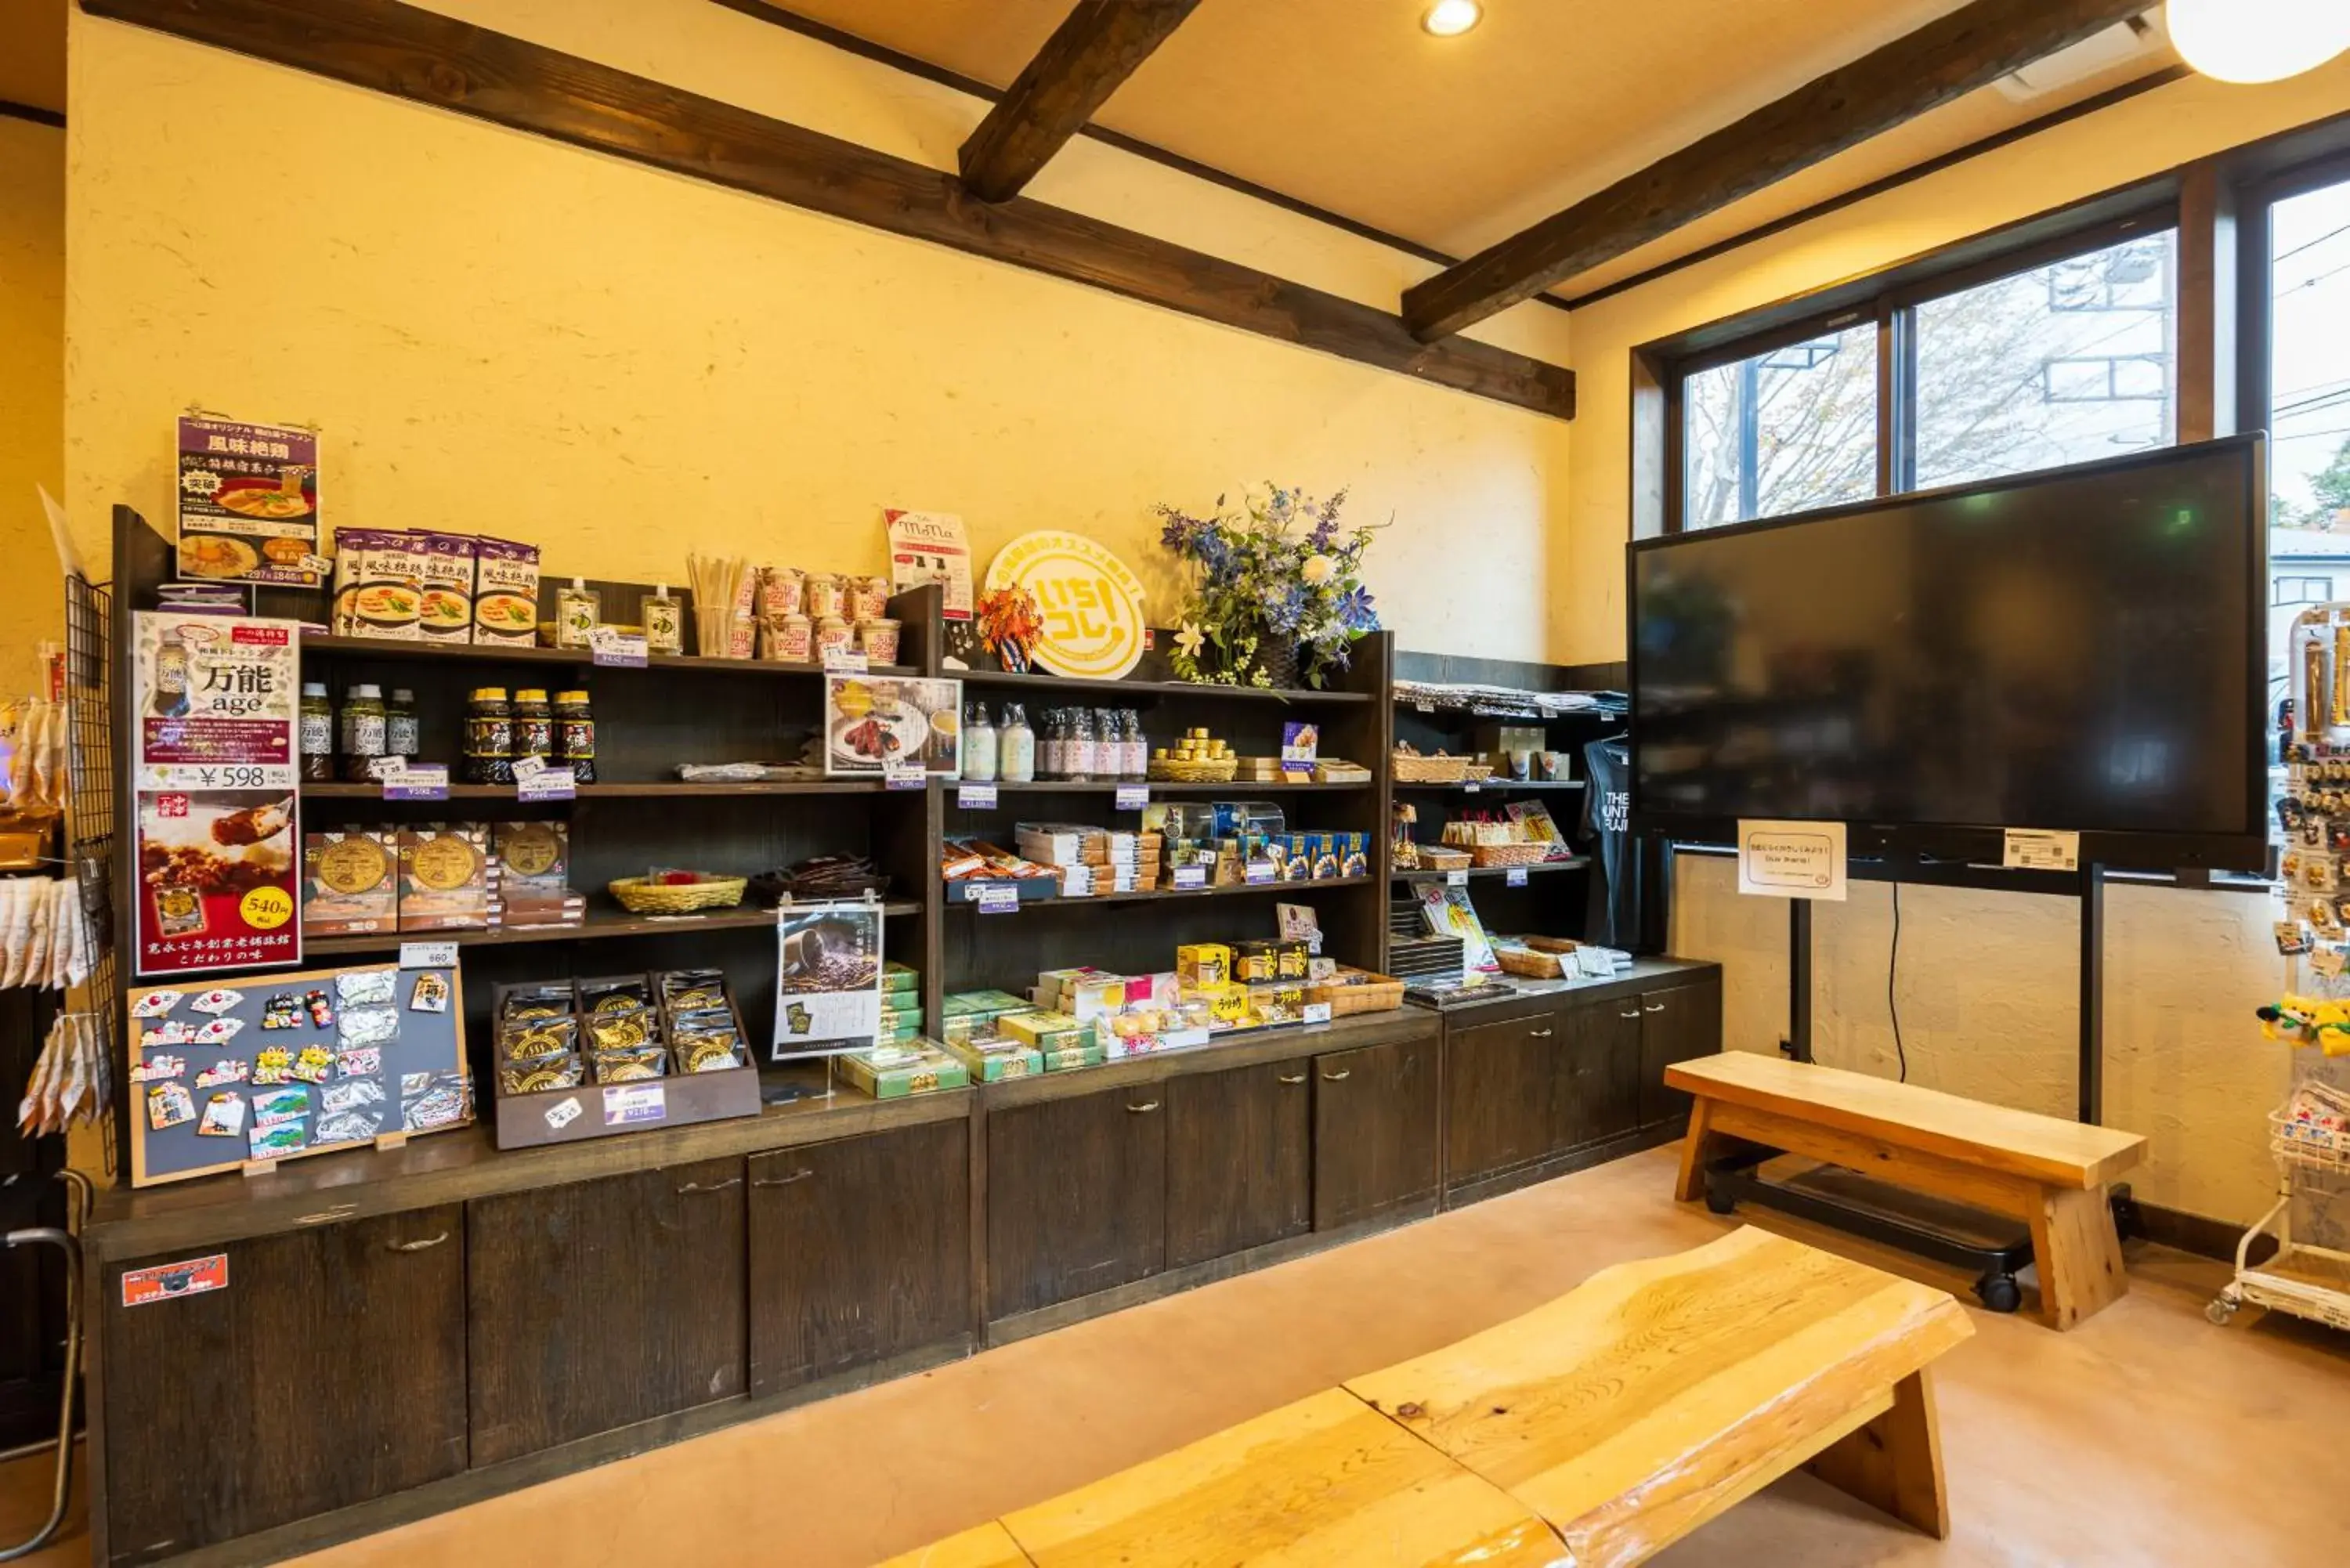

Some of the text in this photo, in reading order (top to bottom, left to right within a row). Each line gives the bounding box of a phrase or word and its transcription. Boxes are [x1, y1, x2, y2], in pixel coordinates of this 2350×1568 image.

[202, 665, 273, 693] 万能
[212, 697, 262, 716] age
[1606, 791, 1630, 805] THE
[179, 948, 263, 965] こだわりの味
